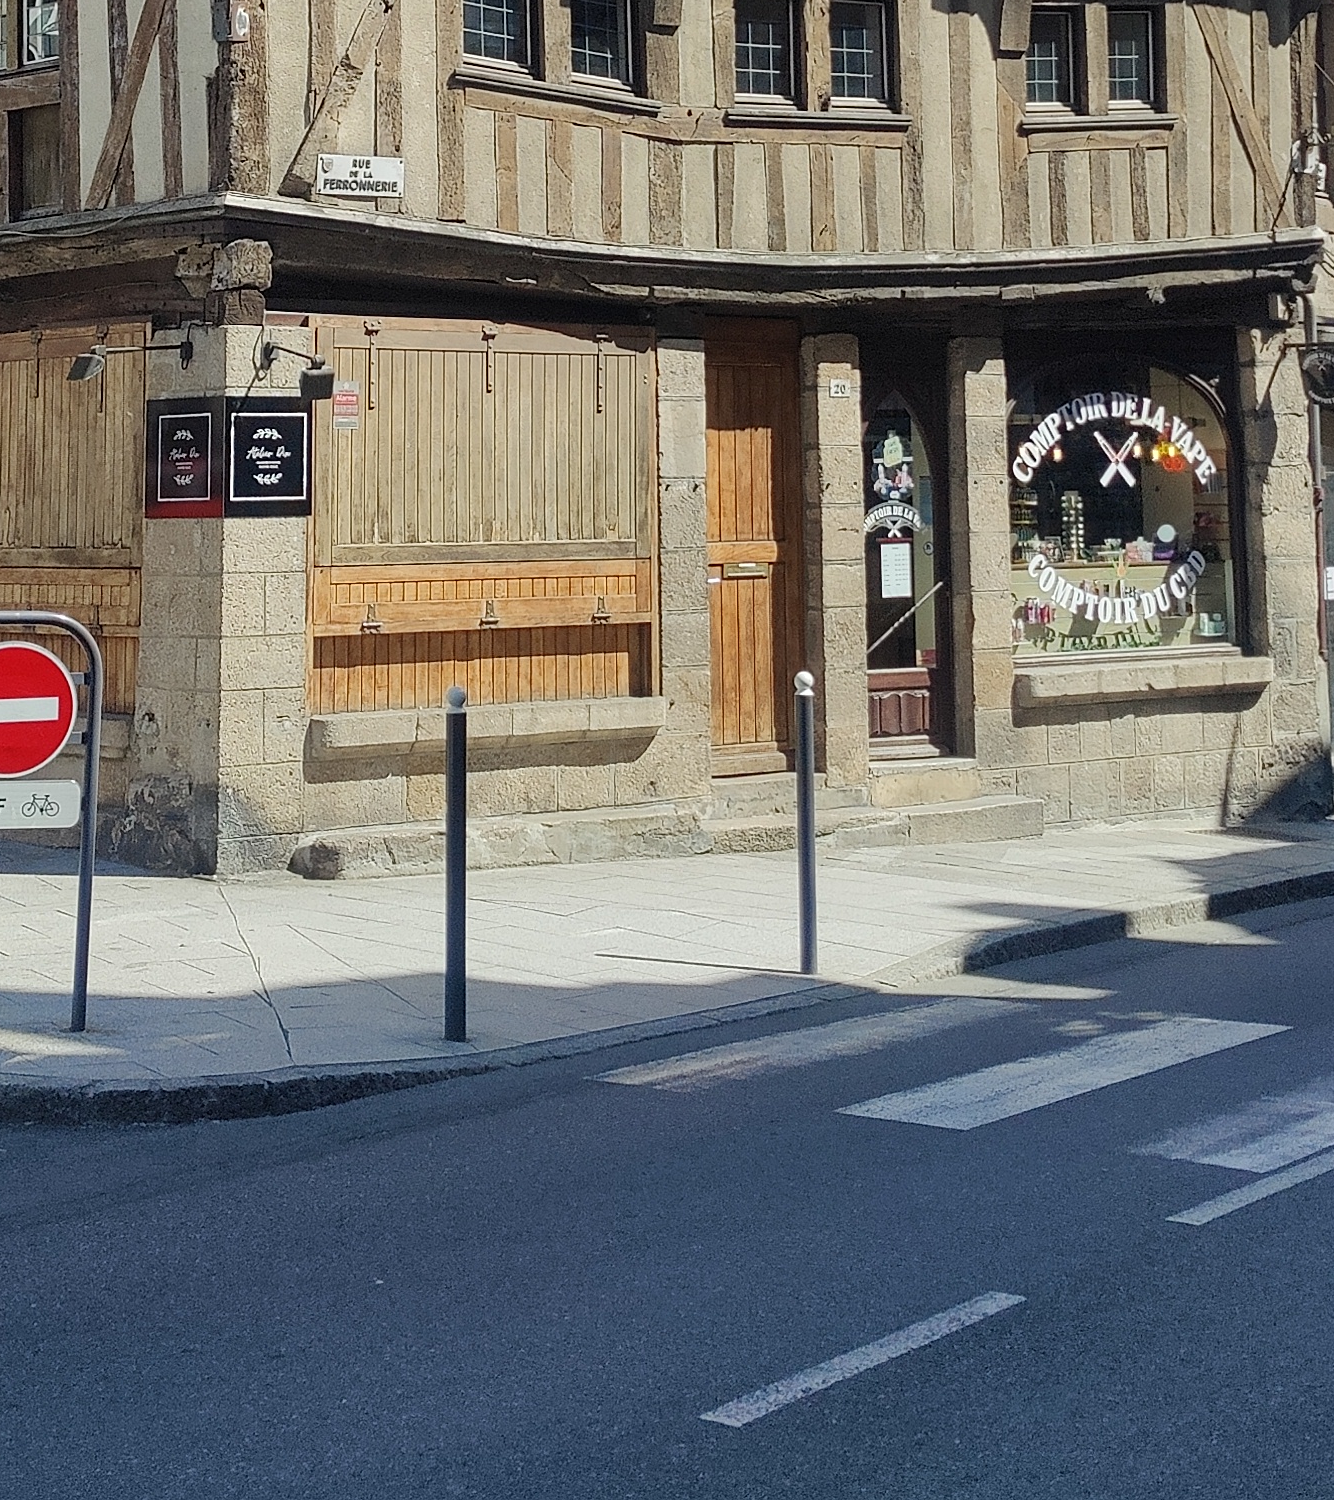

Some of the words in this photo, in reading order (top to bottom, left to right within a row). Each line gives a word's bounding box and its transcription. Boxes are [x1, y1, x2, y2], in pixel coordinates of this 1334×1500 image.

[352, 158, 371, 169] RUE
[349, 170, 359, 178] DE
[363, 171, 373, 179] LA
[323, 178, 398, 193] FERRONNERIE
[833, 384, 846, 395] 20
[1012, 392, 1108, 484] COMPTOIR
[1111, 391, 1139, 419] DE
[1140, 397, 1165, 434] LA
[1169, 415, 1217, 485] VAPE
[245, 445, 273, 459] Atelier
[893, 505, 903, 516] DE
[903, 507, 913, 521] LA
[1028, 554, 1139, 624] COMPTOIR
[1139, 584, 1170, 619] DU
[1169, 550, 1207, 600] CBD
